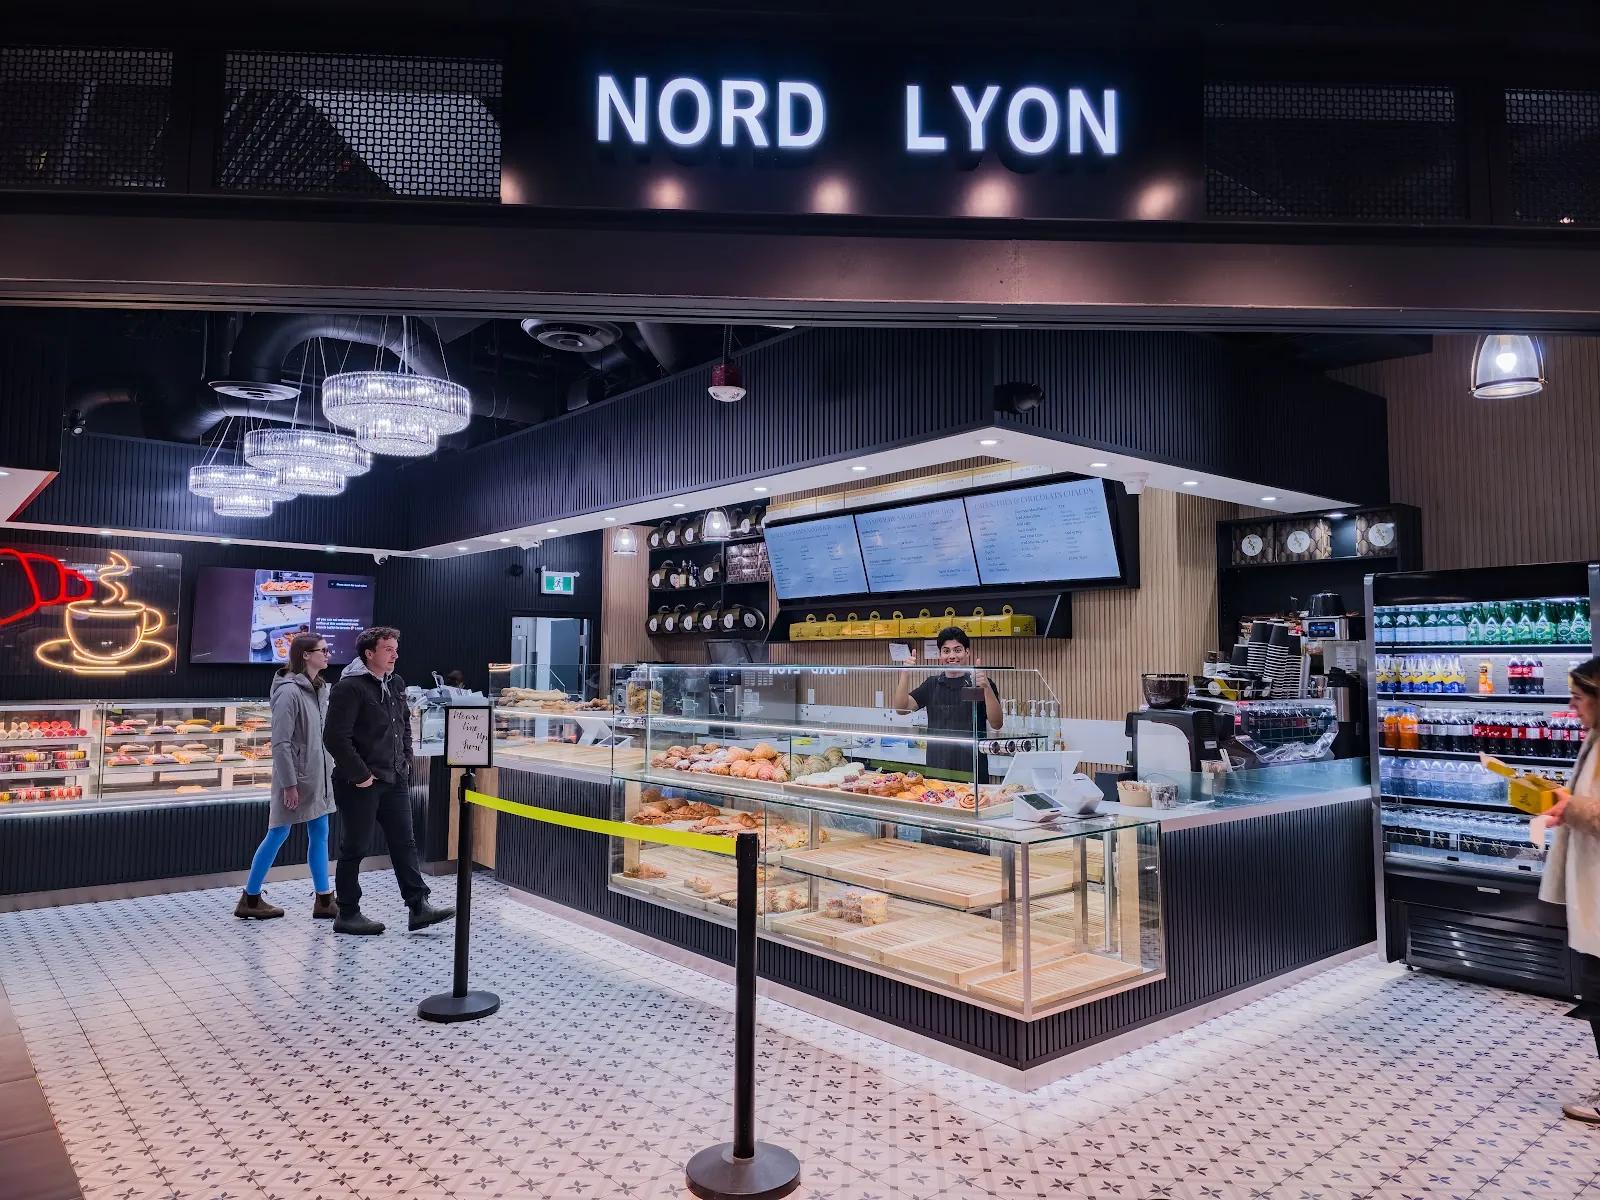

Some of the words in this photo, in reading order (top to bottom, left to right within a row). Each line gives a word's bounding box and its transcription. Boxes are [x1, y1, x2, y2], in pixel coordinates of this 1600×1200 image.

[597, 75, 826, 148] NORD
[905, 84, 1119, 155] LYON
[453, 709, 484, 720] Please
[462, 722, 480, 731] line
[476, 732, 488, 743] up
[463, 739, 483, 751] here
